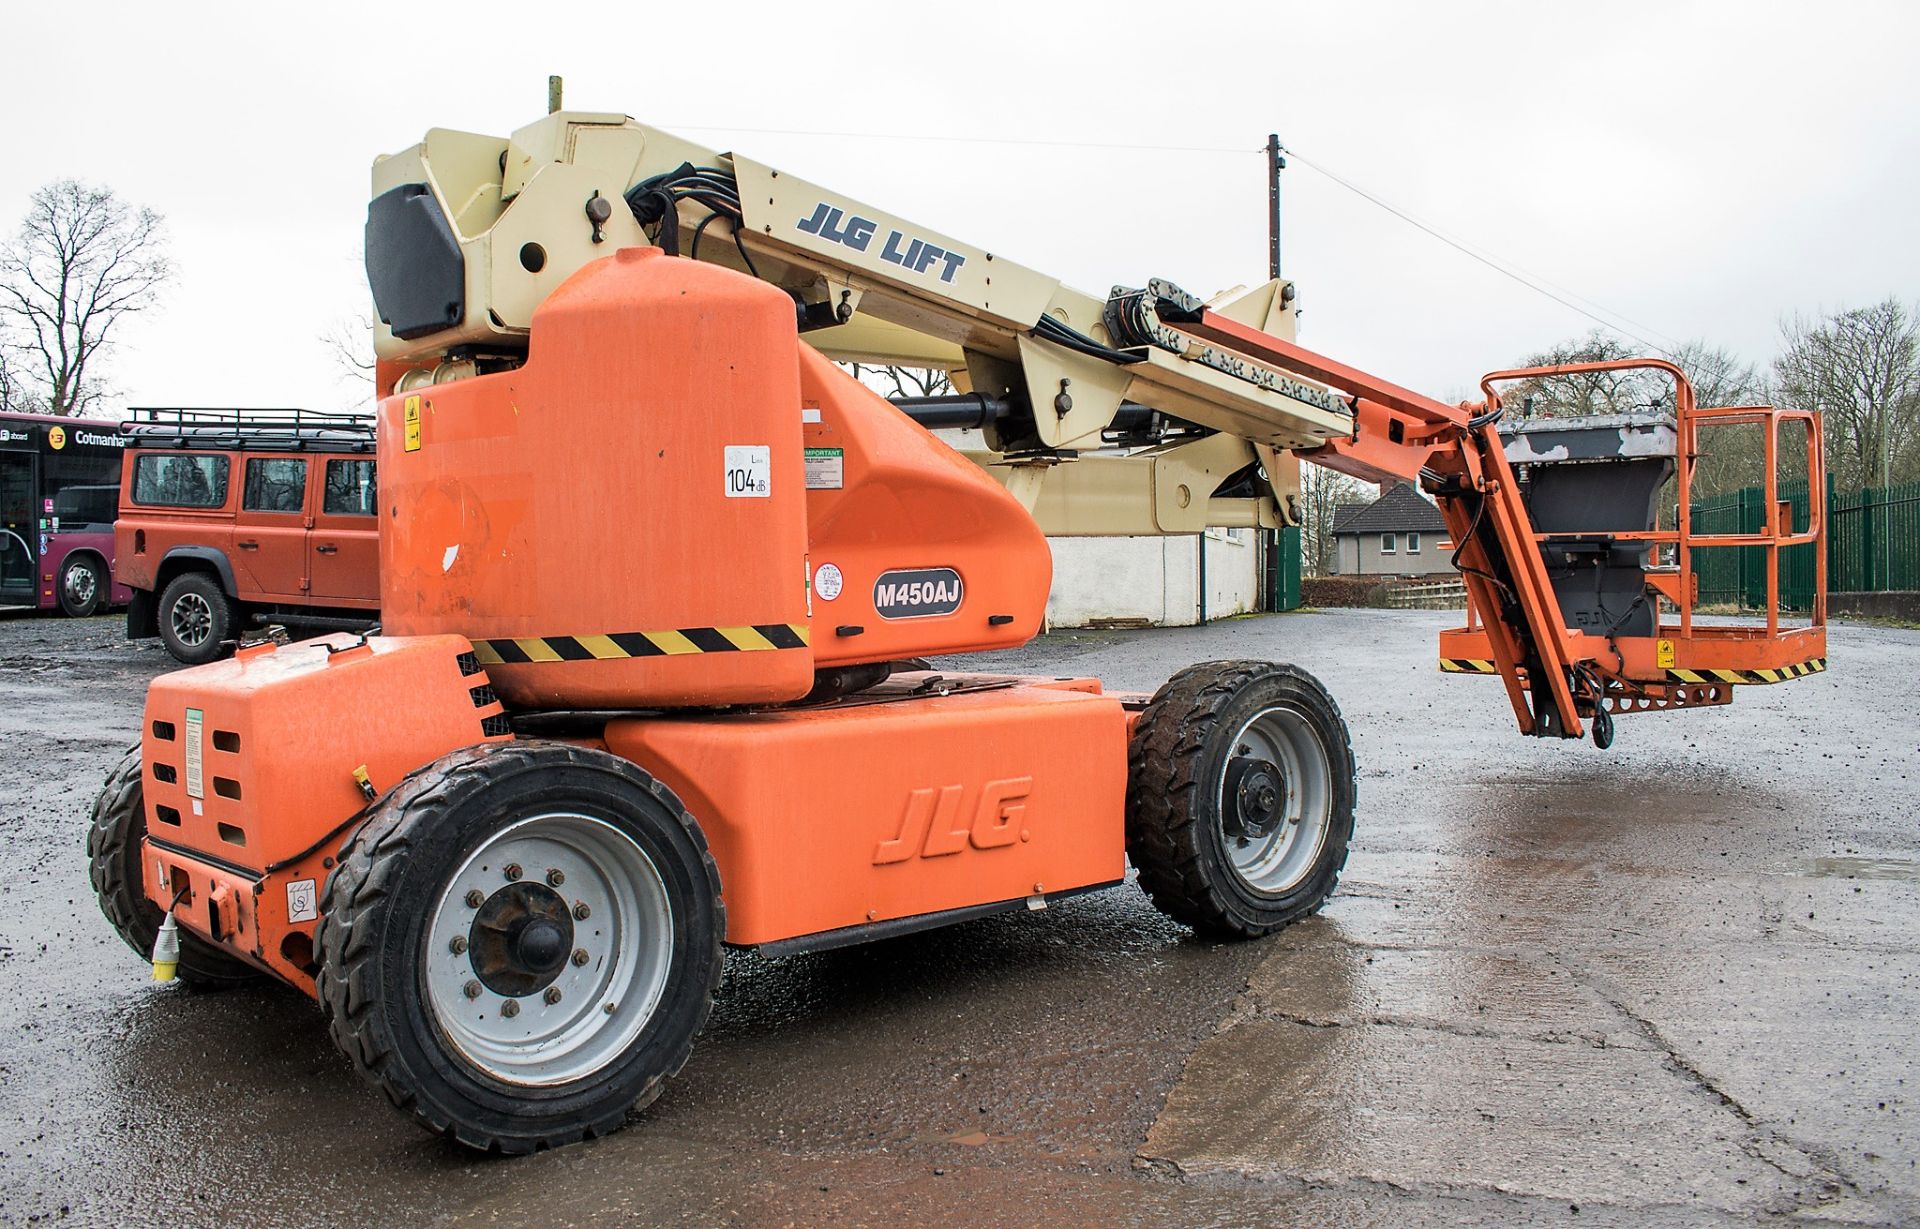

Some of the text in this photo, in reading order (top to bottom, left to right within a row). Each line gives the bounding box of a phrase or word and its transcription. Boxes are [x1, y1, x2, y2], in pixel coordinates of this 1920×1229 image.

[797, 203, 966, 283] JLG LIFT
[75, 430, 126, 447] Cotmanha
[727, 469, 755, 492] 104
[877, 579, 959, 608] M450AJ
